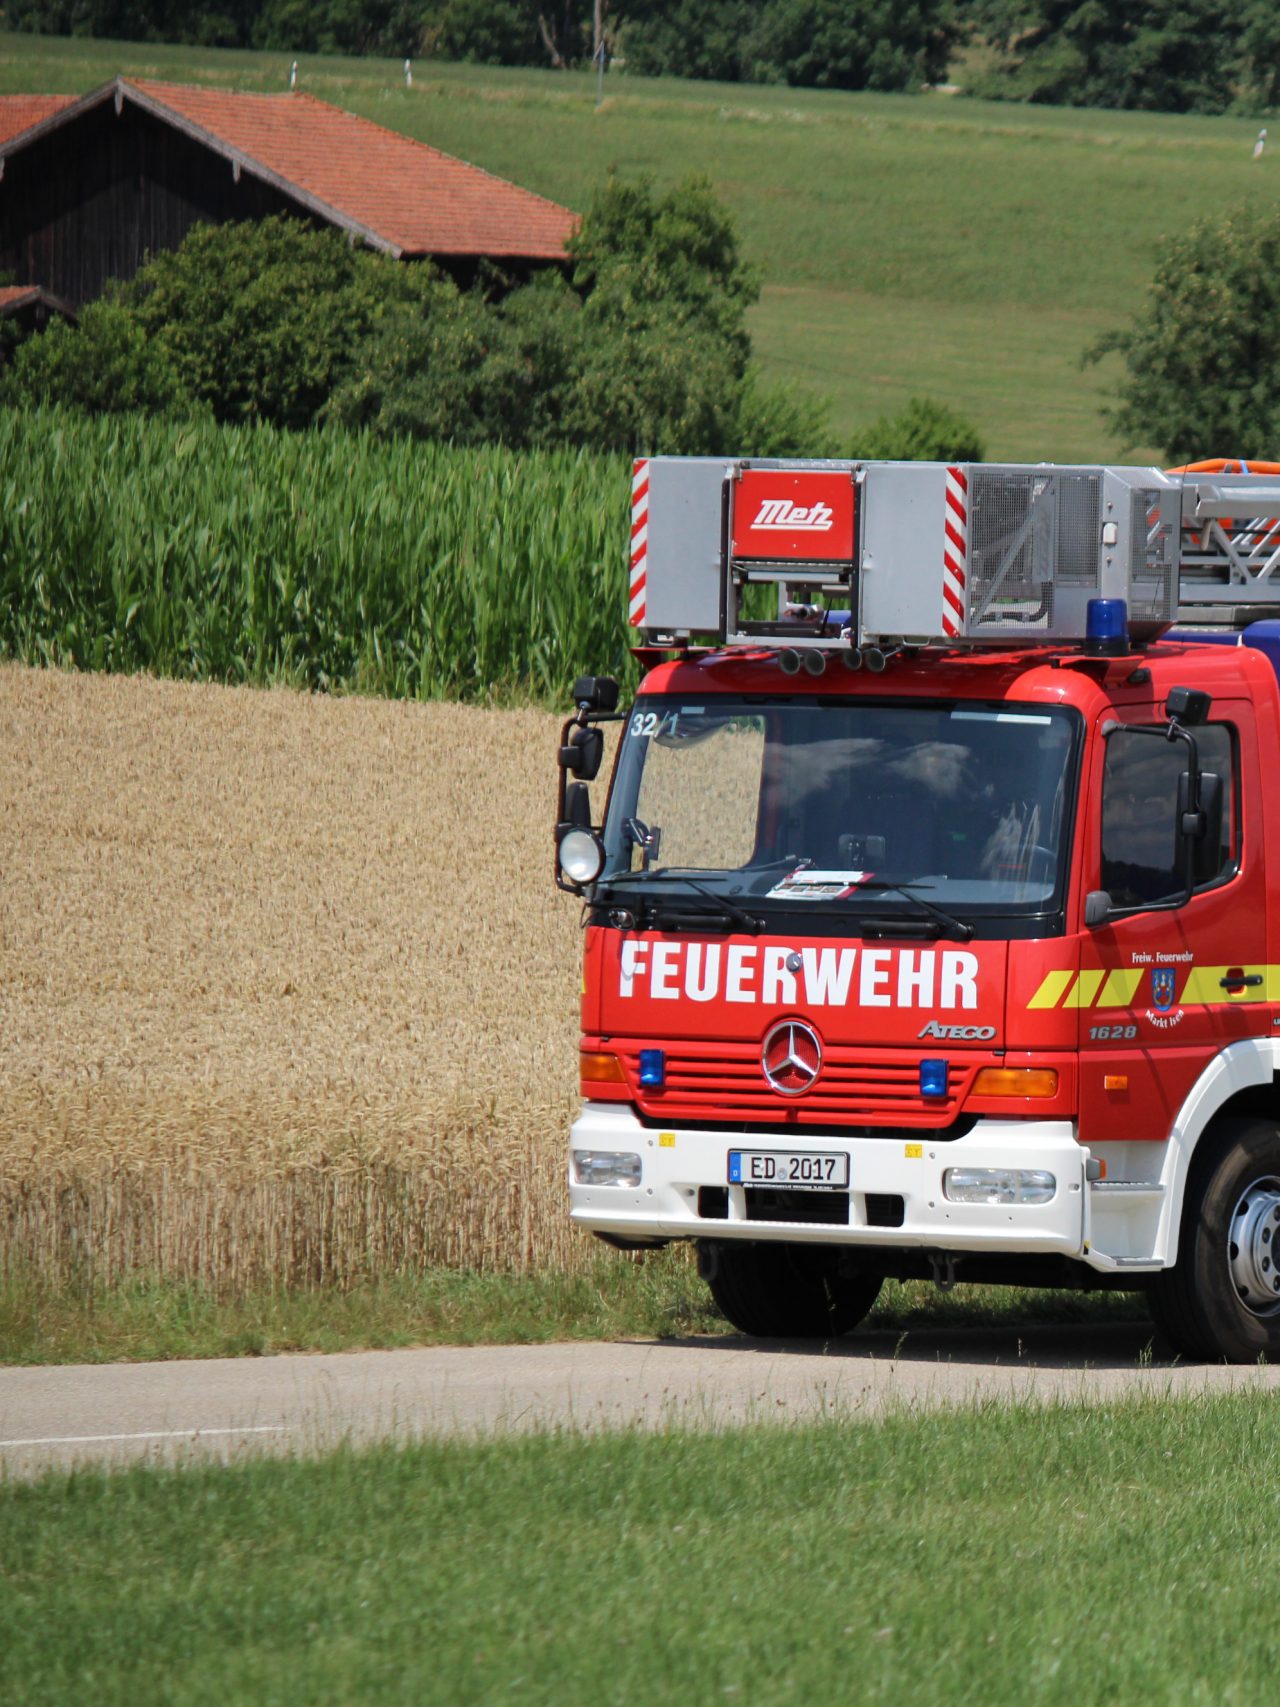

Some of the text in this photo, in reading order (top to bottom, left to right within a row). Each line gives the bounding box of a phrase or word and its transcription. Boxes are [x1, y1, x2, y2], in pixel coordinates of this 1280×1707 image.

[750, 500, 833, 531] Metz
[631, 711, 679, 738] 32/1
[1132, 951, 1194, 963] Freiw. Feuerwehr
[619, 940, 979, 1009] FEUERWEHR
[1145, 1009, 1168, 1028] Markt
[1089, 1026, 1137, 1040] 1628
[751, 1157, 836, 1181] ED 2017
